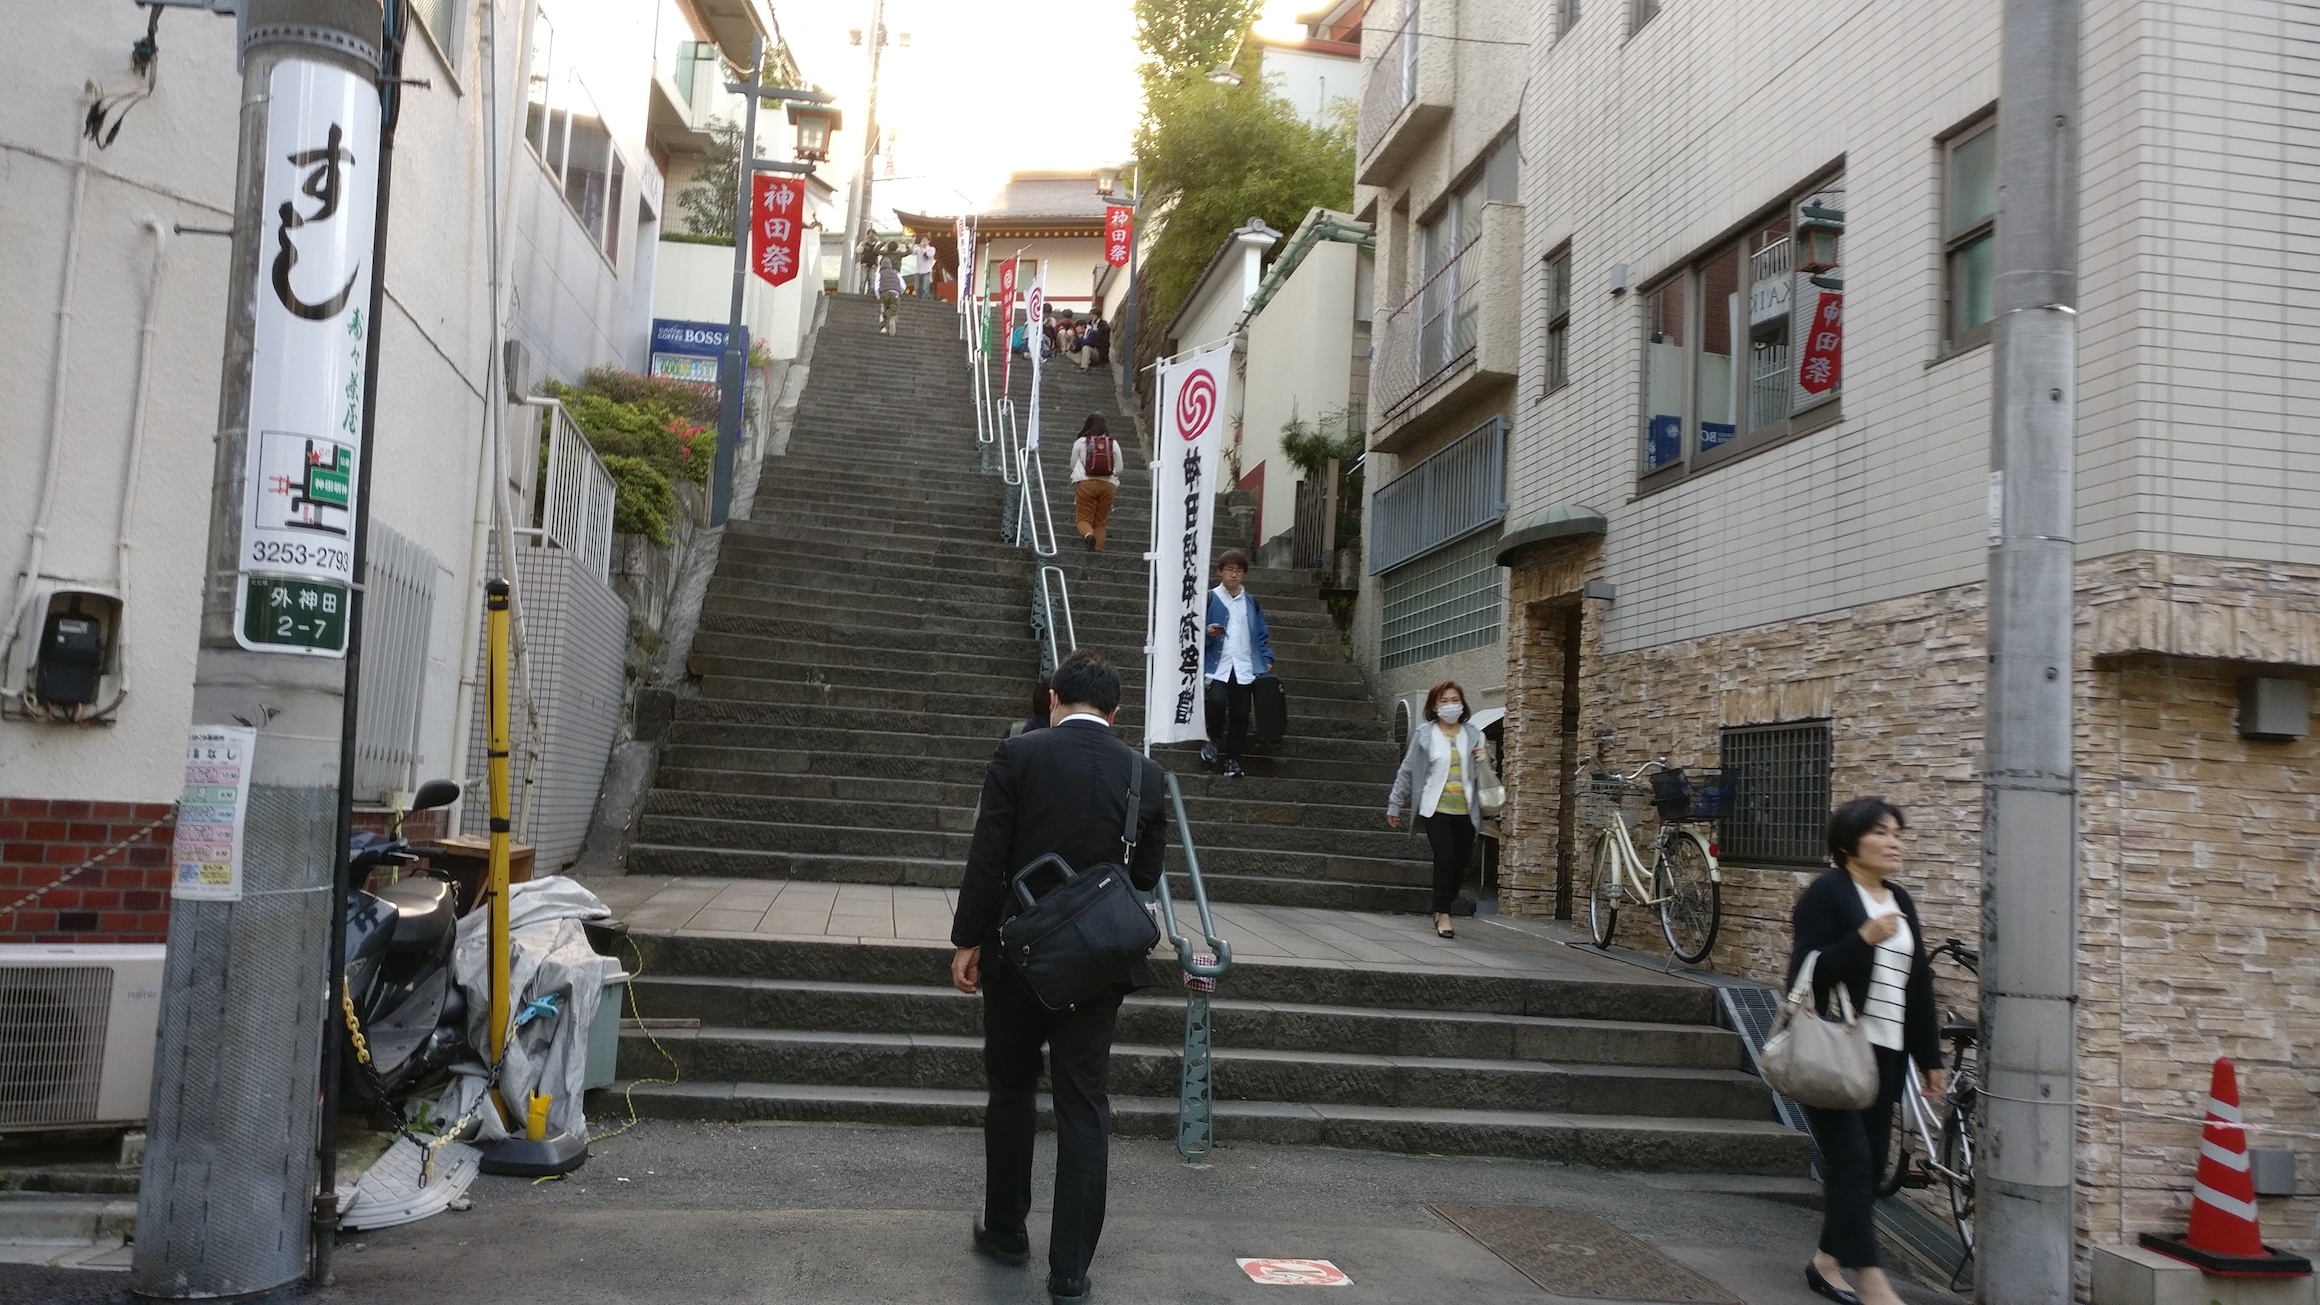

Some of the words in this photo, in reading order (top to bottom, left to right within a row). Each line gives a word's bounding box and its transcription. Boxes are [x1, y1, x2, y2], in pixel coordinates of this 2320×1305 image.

[272, 121, 360, 321] すし
[761, 183, 796, 275] 神田祭
[1110, 210, 1128, 261] 神田祭
[684, 329, 723, 345] BOSS
[252, 541, 349, 573] 3253-2793
[271, 587, 337, 614] 外神田
[277, 615, 327, 640] 2-7
